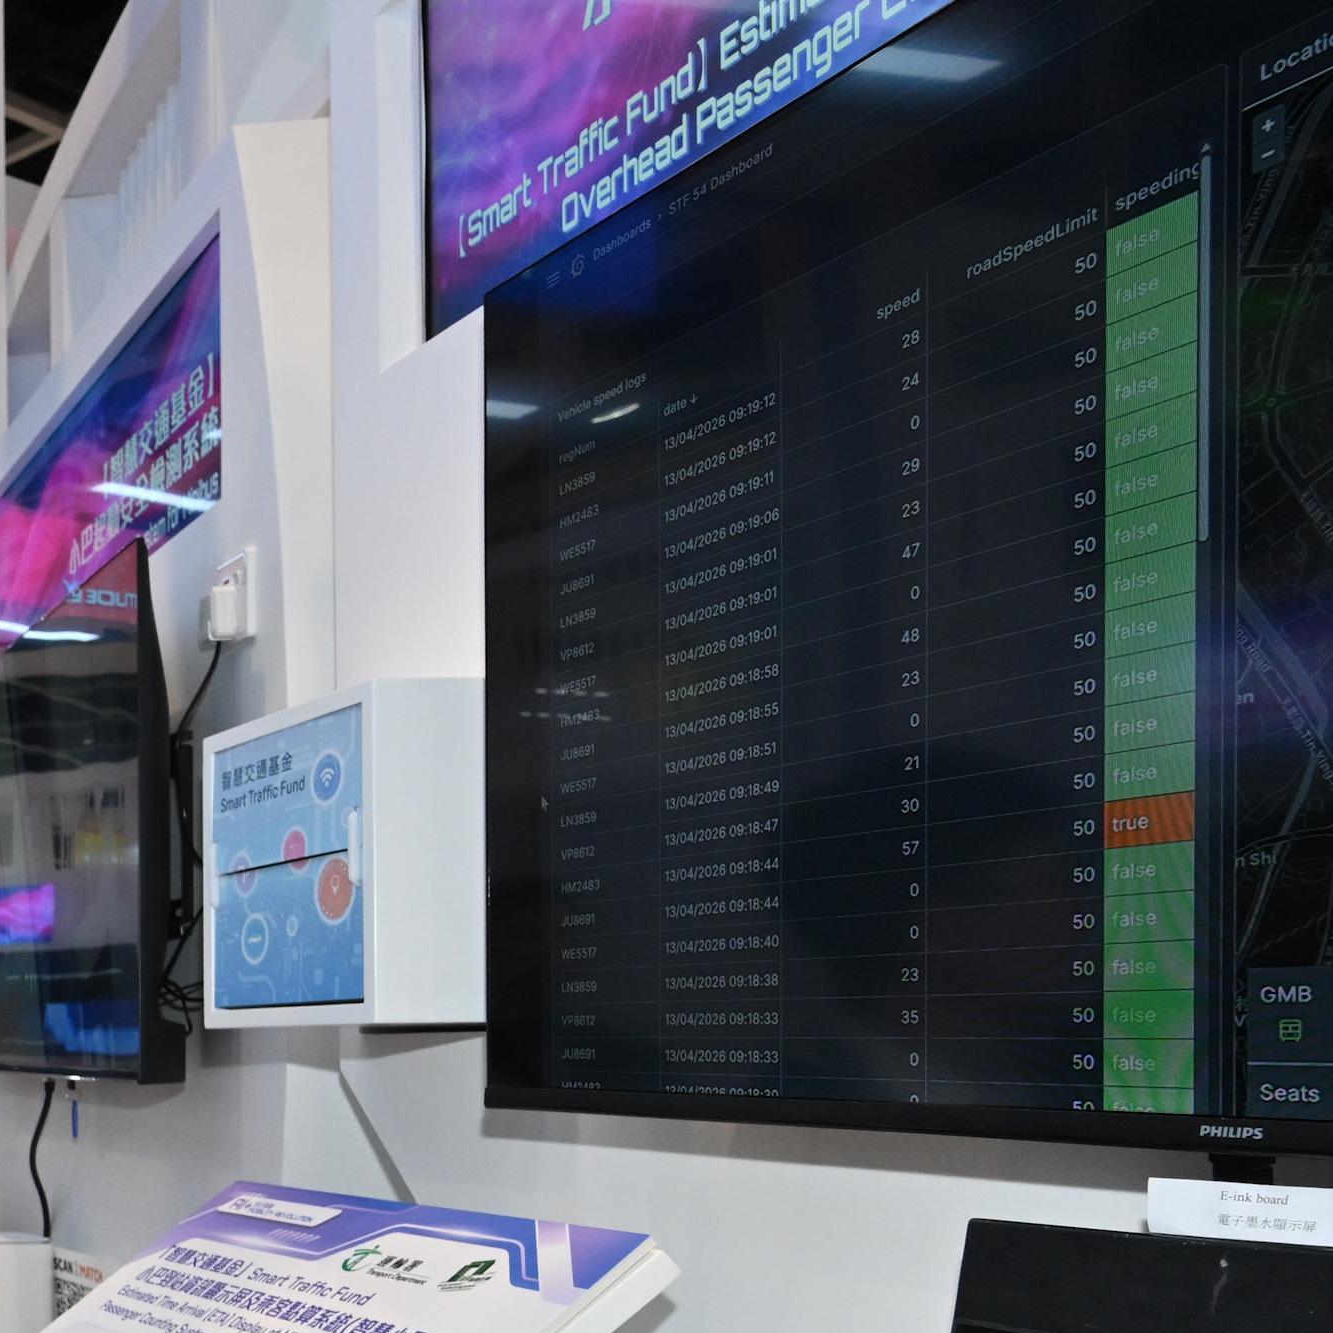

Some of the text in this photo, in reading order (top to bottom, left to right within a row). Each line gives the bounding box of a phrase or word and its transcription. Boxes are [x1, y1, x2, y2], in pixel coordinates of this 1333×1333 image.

[562, 0, 875, 236] Overhead Passenger
[538, 118, 620, 195] Traffic
[592, 142, 774, 261] Dashboards STF 54 Dashboard
[559, 439, 596, 466] regNum
[663, 397, 687, 418] date
[875, 288, 921, 321] speed
[966, 207, 1099, 280] roadSpeedLimit
[559, 227, 1160, 497] LN3859 13/04/2026 09:19:12 28 50 false
[556, 371, 648, 423] Vehicle speed logs
[559, 275, 1160, 530] HM2483 13/04/2026 09:19:12 24 50 false
[559, 325, 1160, 563] WE5517 13/04/2026 09:19:11 0 50 false
[222, 752, 293, 790] 智慧交通基金
[221, 775, 305, 813] Smart Traffic Fund
[561, 813, 1149, 895] HM2483 13/04/2026 09:18:44 57 50 true
[1260, 985, 1312, 1004] GMB
[1259, 1082, 1320, 1104] Seats
[1199, 1125, 1263, 1139] PHILIPS
[1221, 1190, 1289, 1205] E-ink board
[1218, 1214, 1317, 1232] 電子墨水顯示屏
[53, 1257, 73, 1272] SCAN
[391, 1273, 427, 1286] Department
[117, 1283, 158, 1308] Estimated
[159, 1293, 180, 1312] Time
[179, 1296, 206, 1319] Arrival
[248, 1266, 285, 1290] Smart
[288, 1274, 331, 1298] Traffic
[333, 1285, 376, 1307] Fund
[98, 1299, 138, 1328] Passenger
